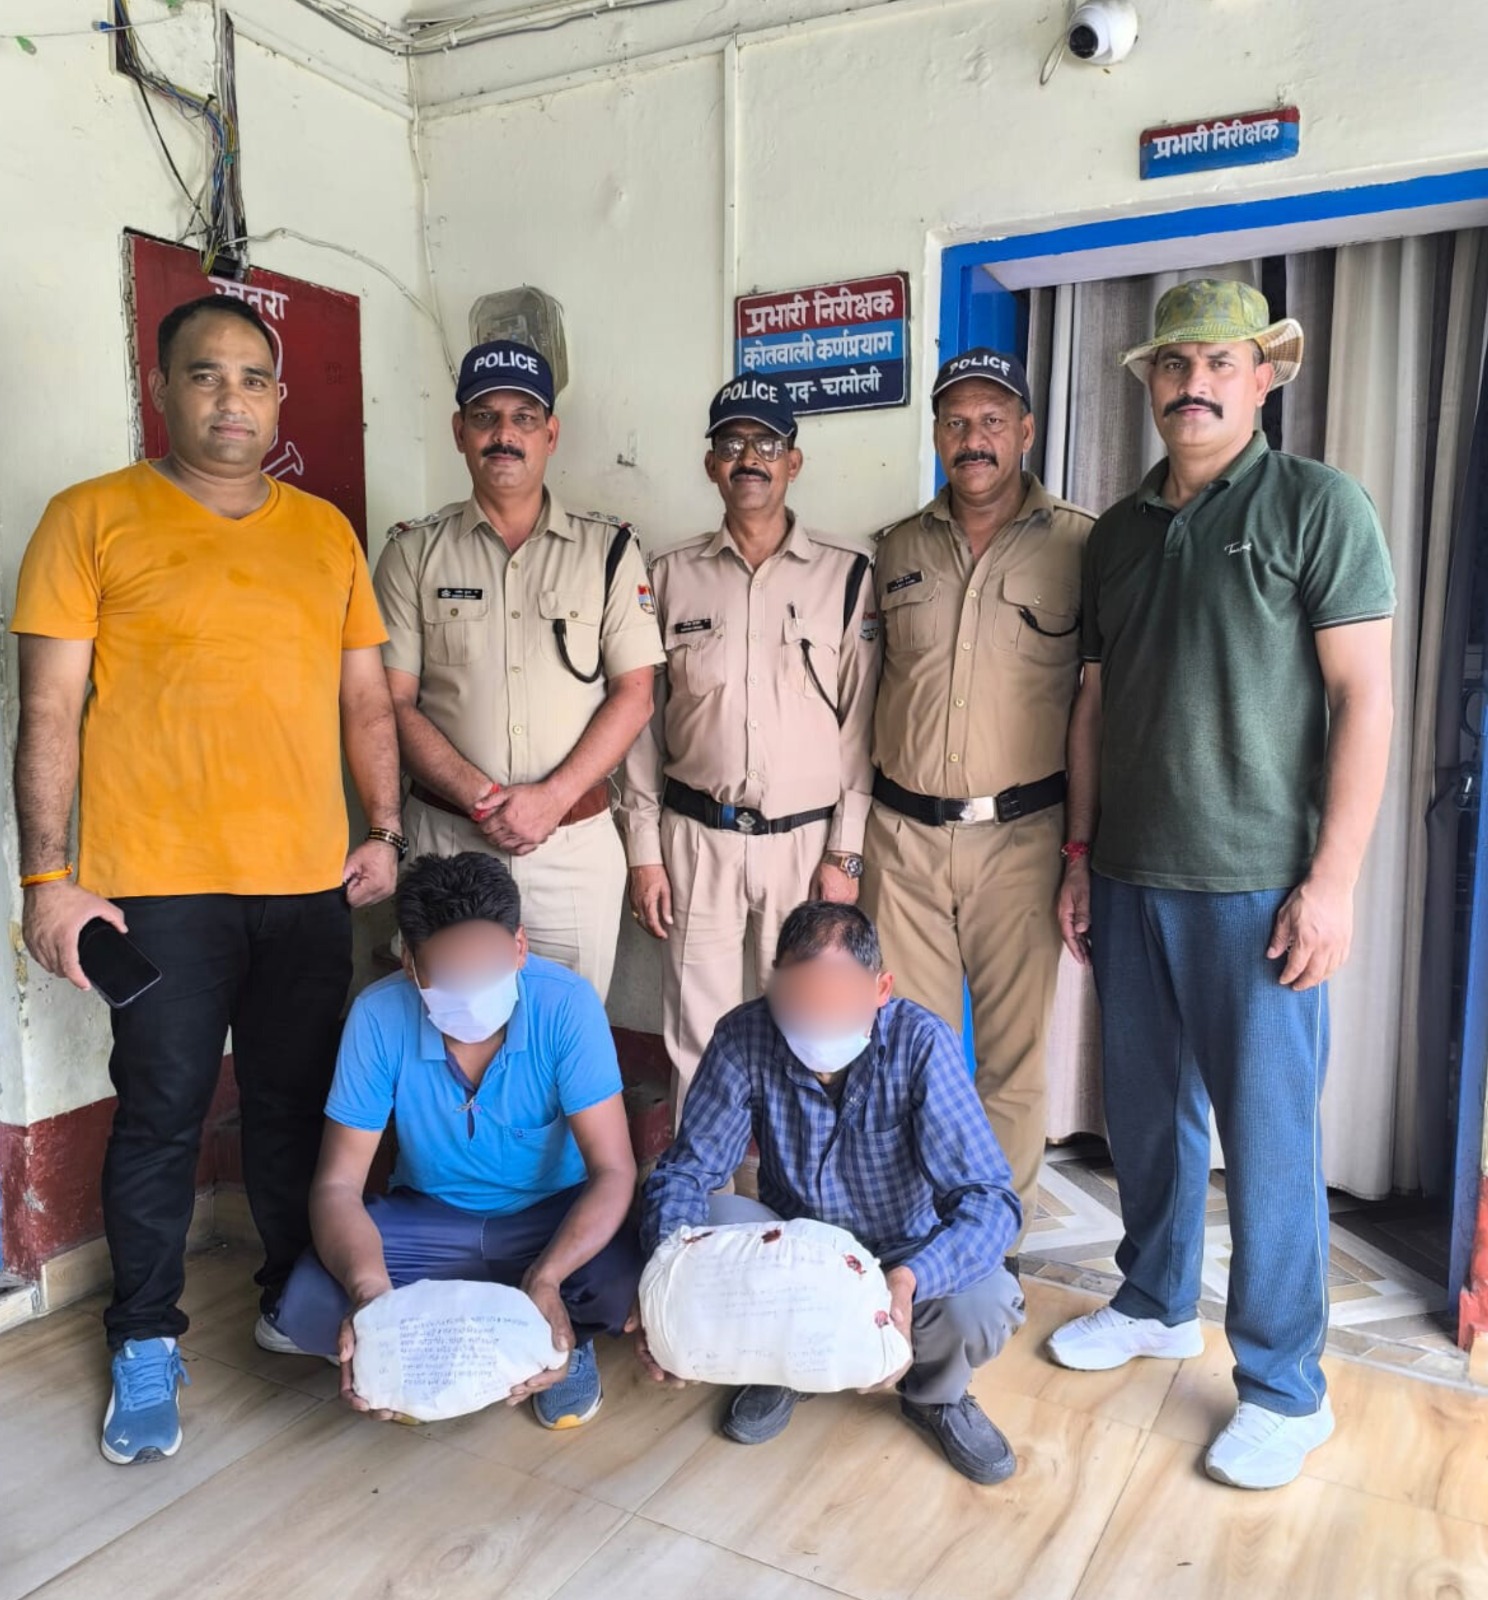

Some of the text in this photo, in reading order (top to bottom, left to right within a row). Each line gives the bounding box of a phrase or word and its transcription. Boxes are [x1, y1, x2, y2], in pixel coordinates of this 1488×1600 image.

[1152, 119, 1280, 159] प्रभारी निरीक्षक
[746, 287, 894, 334] प्रभारी निरीक्षक
[474, 350, 539, 375] POLICE
[743, 329, 894, 370] कोतवाली कर्णप्रयाग
[949, 354, 1011, 377] POLICE
[720, 379, 779, 405] POLICE
[820, 366, 882, 397] चमोली
